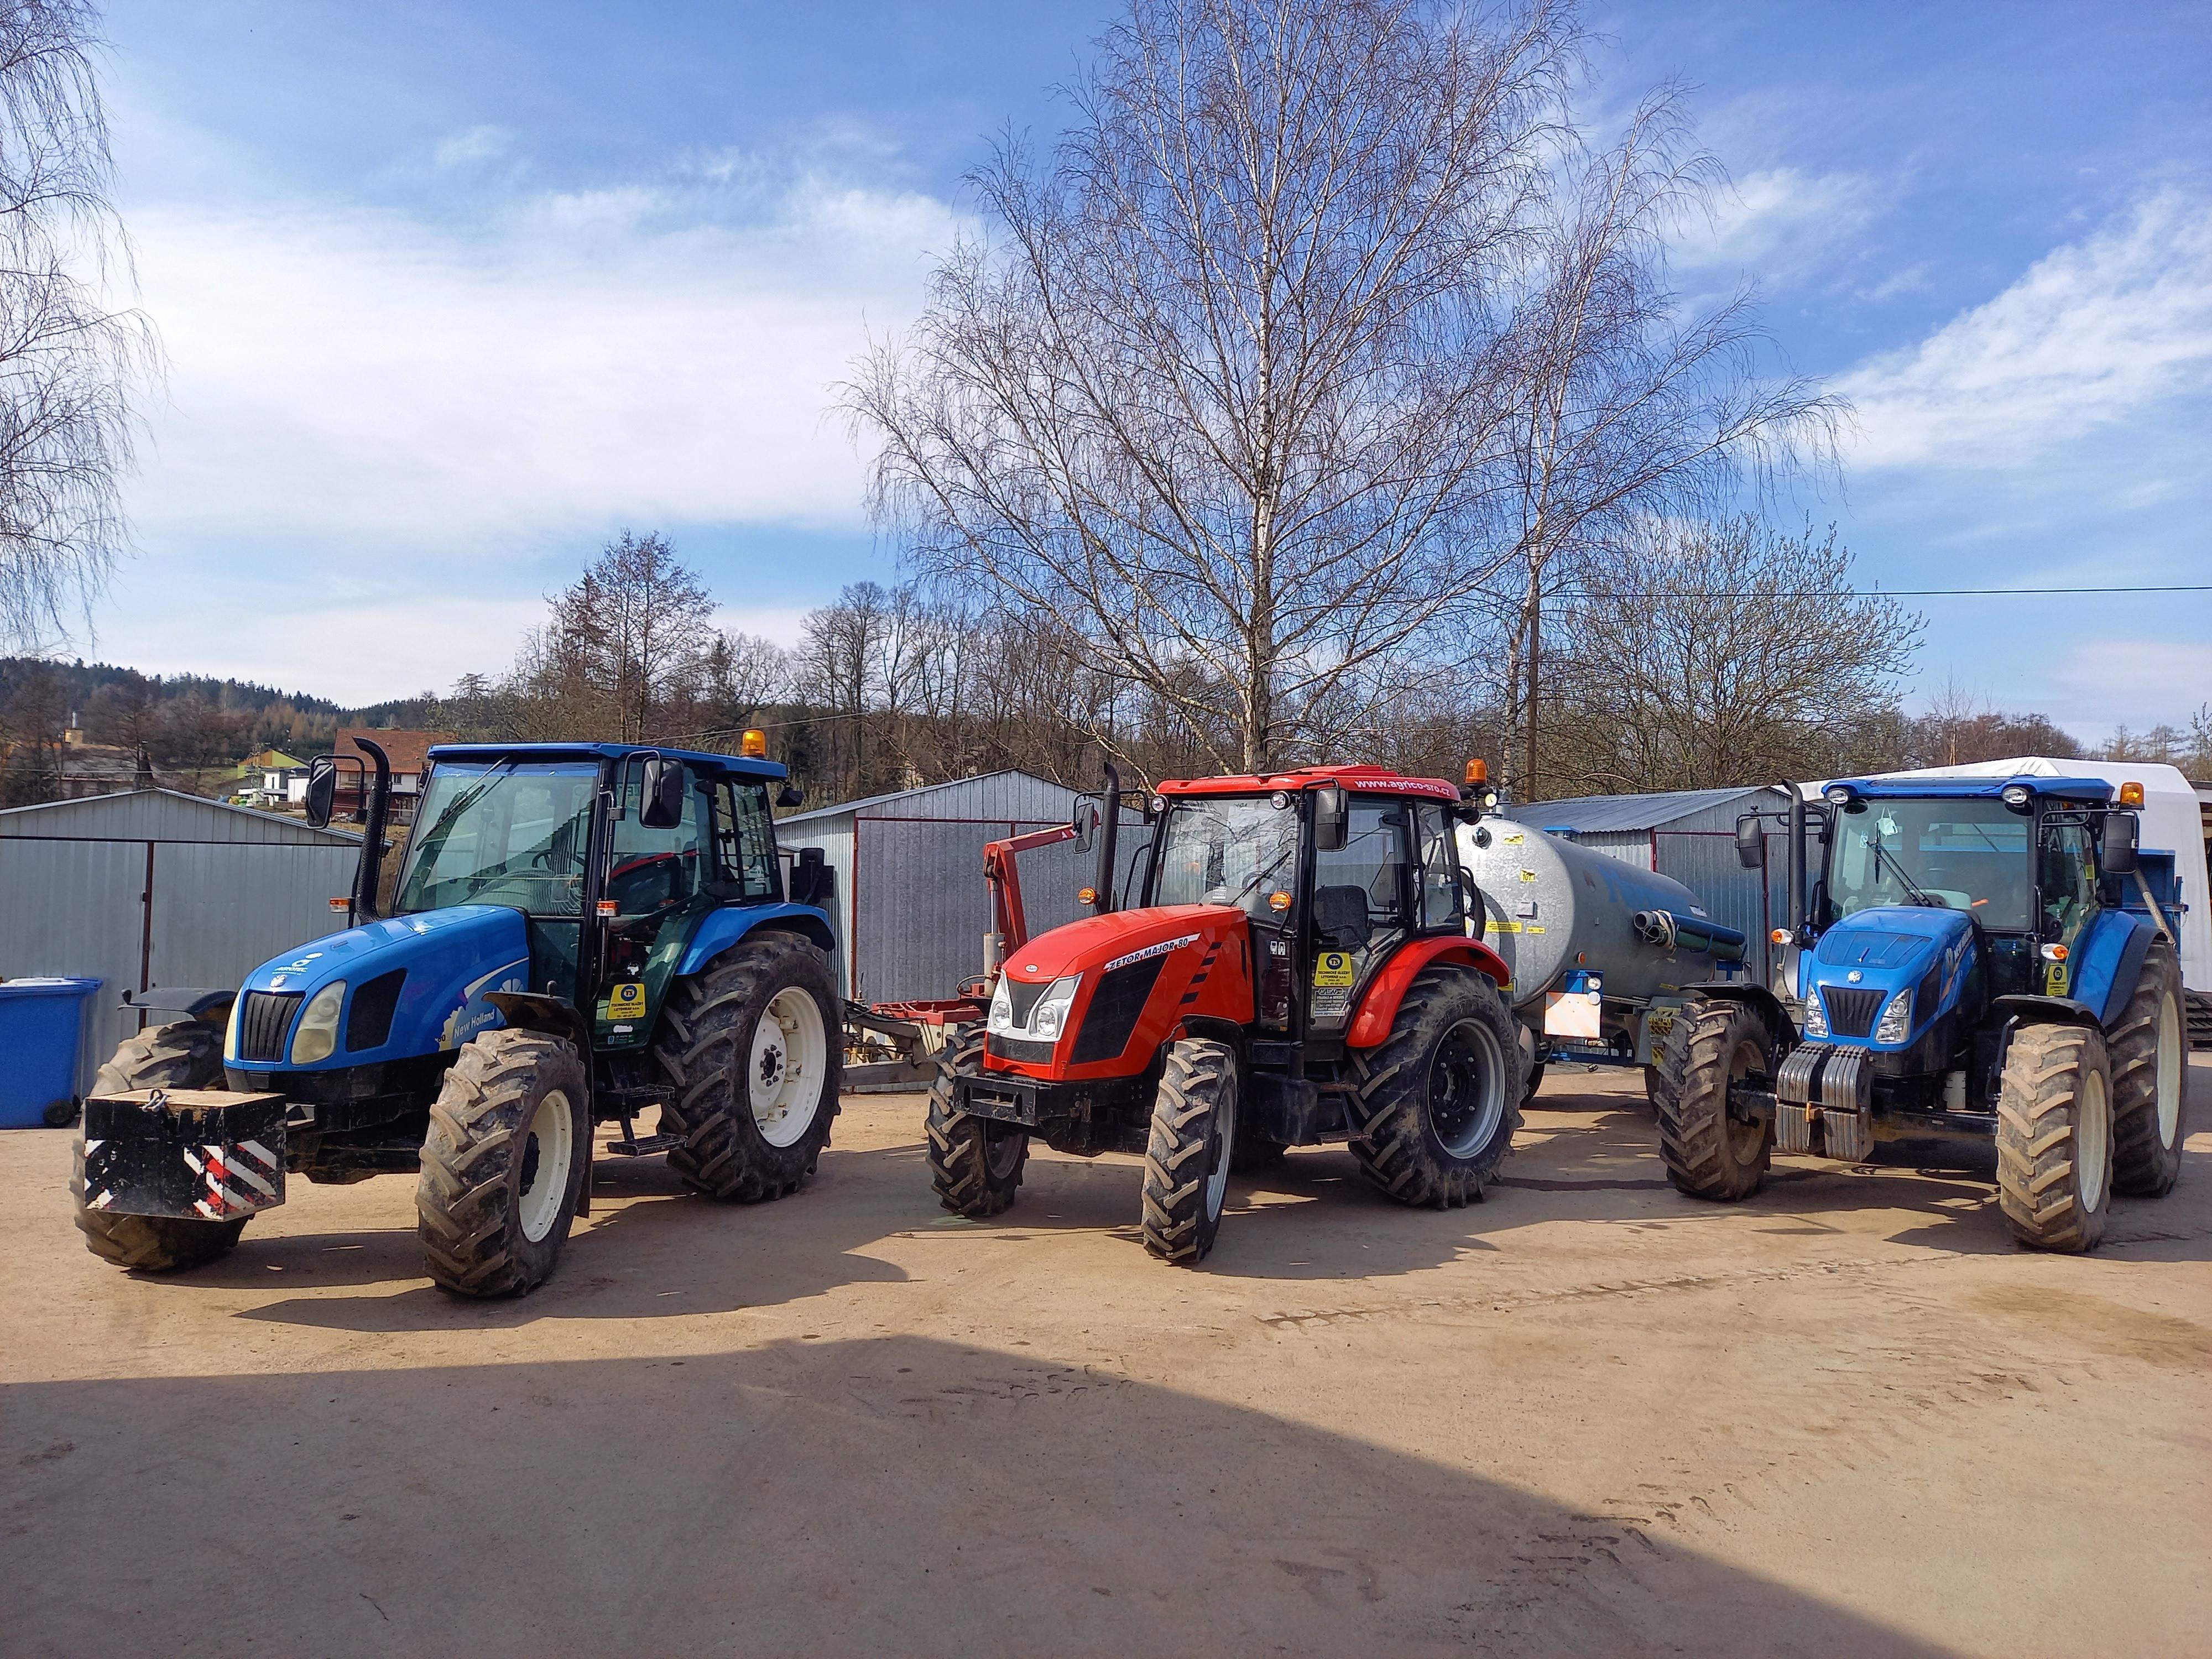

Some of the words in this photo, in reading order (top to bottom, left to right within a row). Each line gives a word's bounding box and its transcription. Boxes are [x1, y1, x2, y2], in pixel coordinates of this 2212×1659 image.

[1355, 780, 1451, 796] www.agrico-sro.cz
[1109, 952, 1140, 970] ZETOR
[1144, 942, 1175, 958] MAJOR
[1178, 938, 1188, 947] 80
[453, 1021, 470, 1040] New
[471, 1008, 495, 1029] Holland
